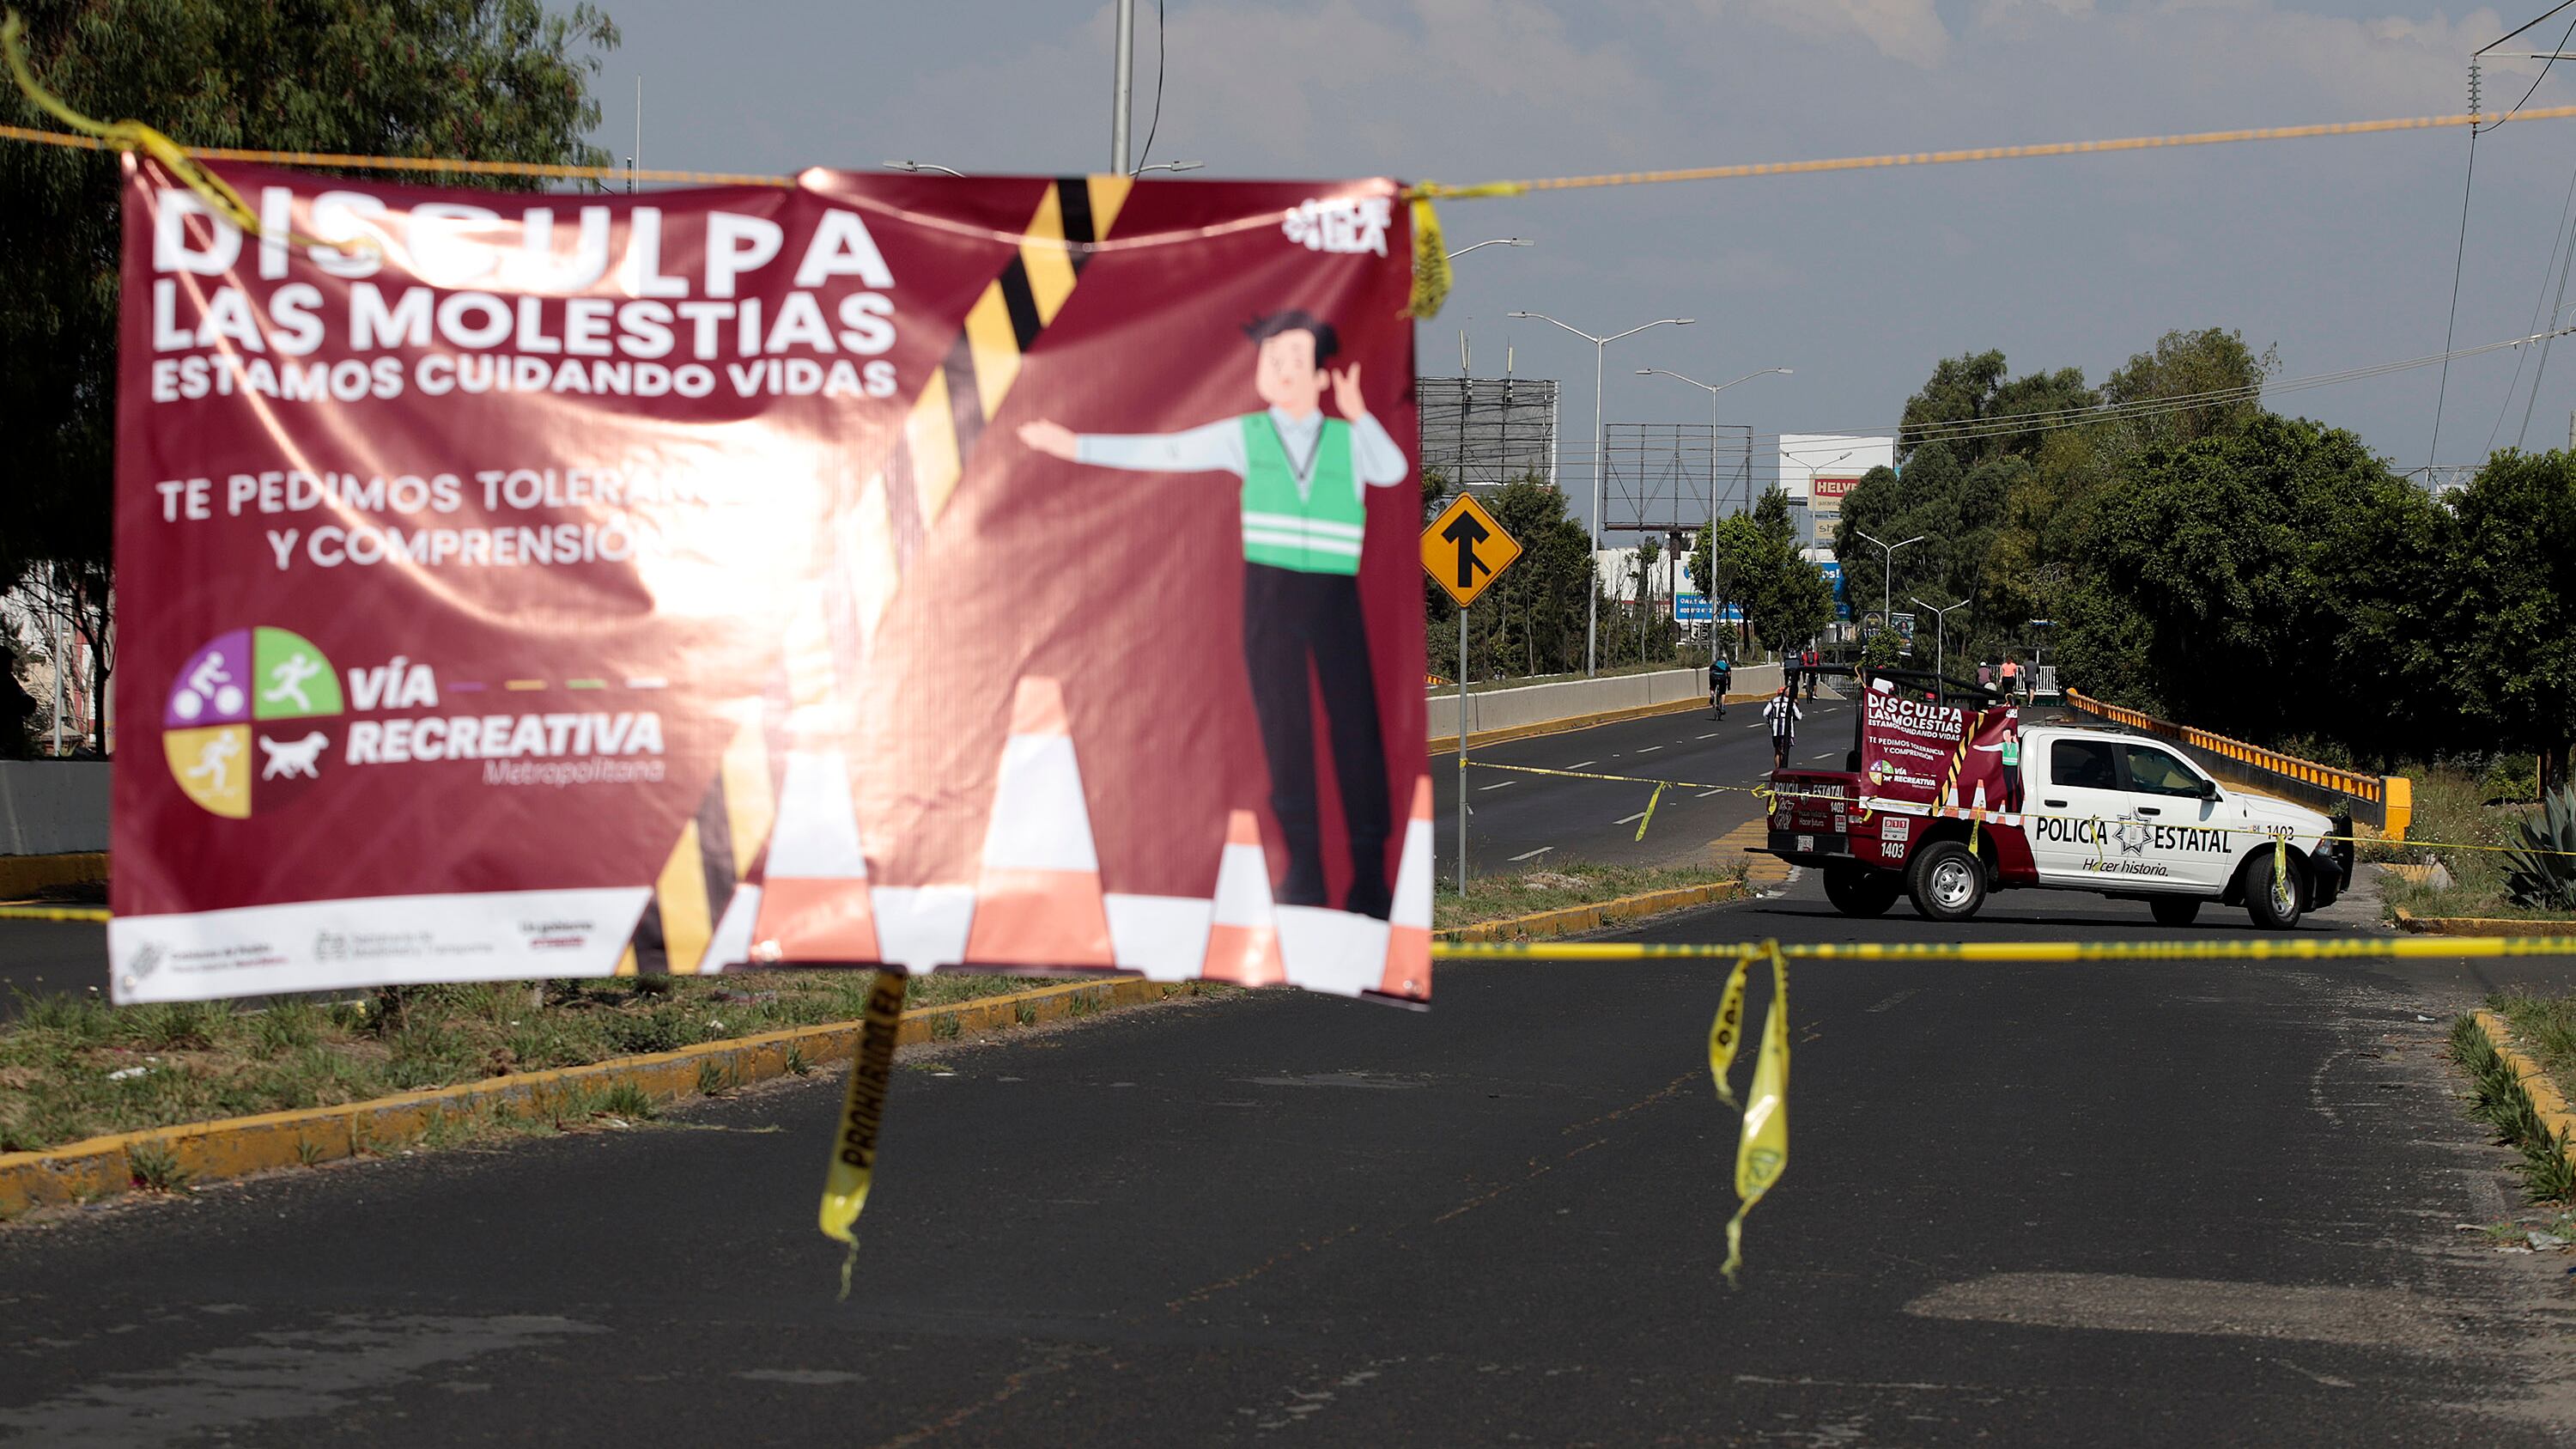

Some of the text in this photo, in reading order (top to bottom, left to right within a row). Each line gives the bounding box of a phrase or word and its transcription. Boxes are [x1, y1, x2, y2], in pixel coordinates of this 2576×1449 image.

[153, 186, 896, 300] DISCULPA
[151, 279, 898, 359] LAS MOLESTIAS
[151, 354, 897, 404] ESTAMOS CUIDANDO VIDAS
[156, 478, 211, 522] TE
[227, 471, 462, 517] PEDIMOS
[267, 514, 640, 570] Y COMPRENSIÓ
[347, 655, 439, 711] VÍA
[1868, 691, 1963, 723] DISCULPA
[1868, 707, 1962, 734] LAS MOLESTIAS
[345, 712, 665, 766] RECREATIVA
[1868, 719, 1960, 741] ESTAMOS CUIDANDO VIDAS
[1878, 738, 1911, 747] PEDIMOS
[1911, 742, 1945, 756] TOLERANCIA
[1889, 746, 1934, 761] COMPRENSIÓN
[482, 755, 665, 788] Metropolitana
[1893, 776, 1936, 786] RECREATIVA
[1774, 780, 1845, 799] POLICÍA ESTATAL
[1831, 801, 1844, 813] 1403
[1885, 819, 1907, 829] 911
[2267, 825, 2294, 841] 1403
[1880, 843, 1905, 859] 1403
[2154, 825, 2232, 854] ESTATAL
[2121, 860, 2169, 877] historia.
